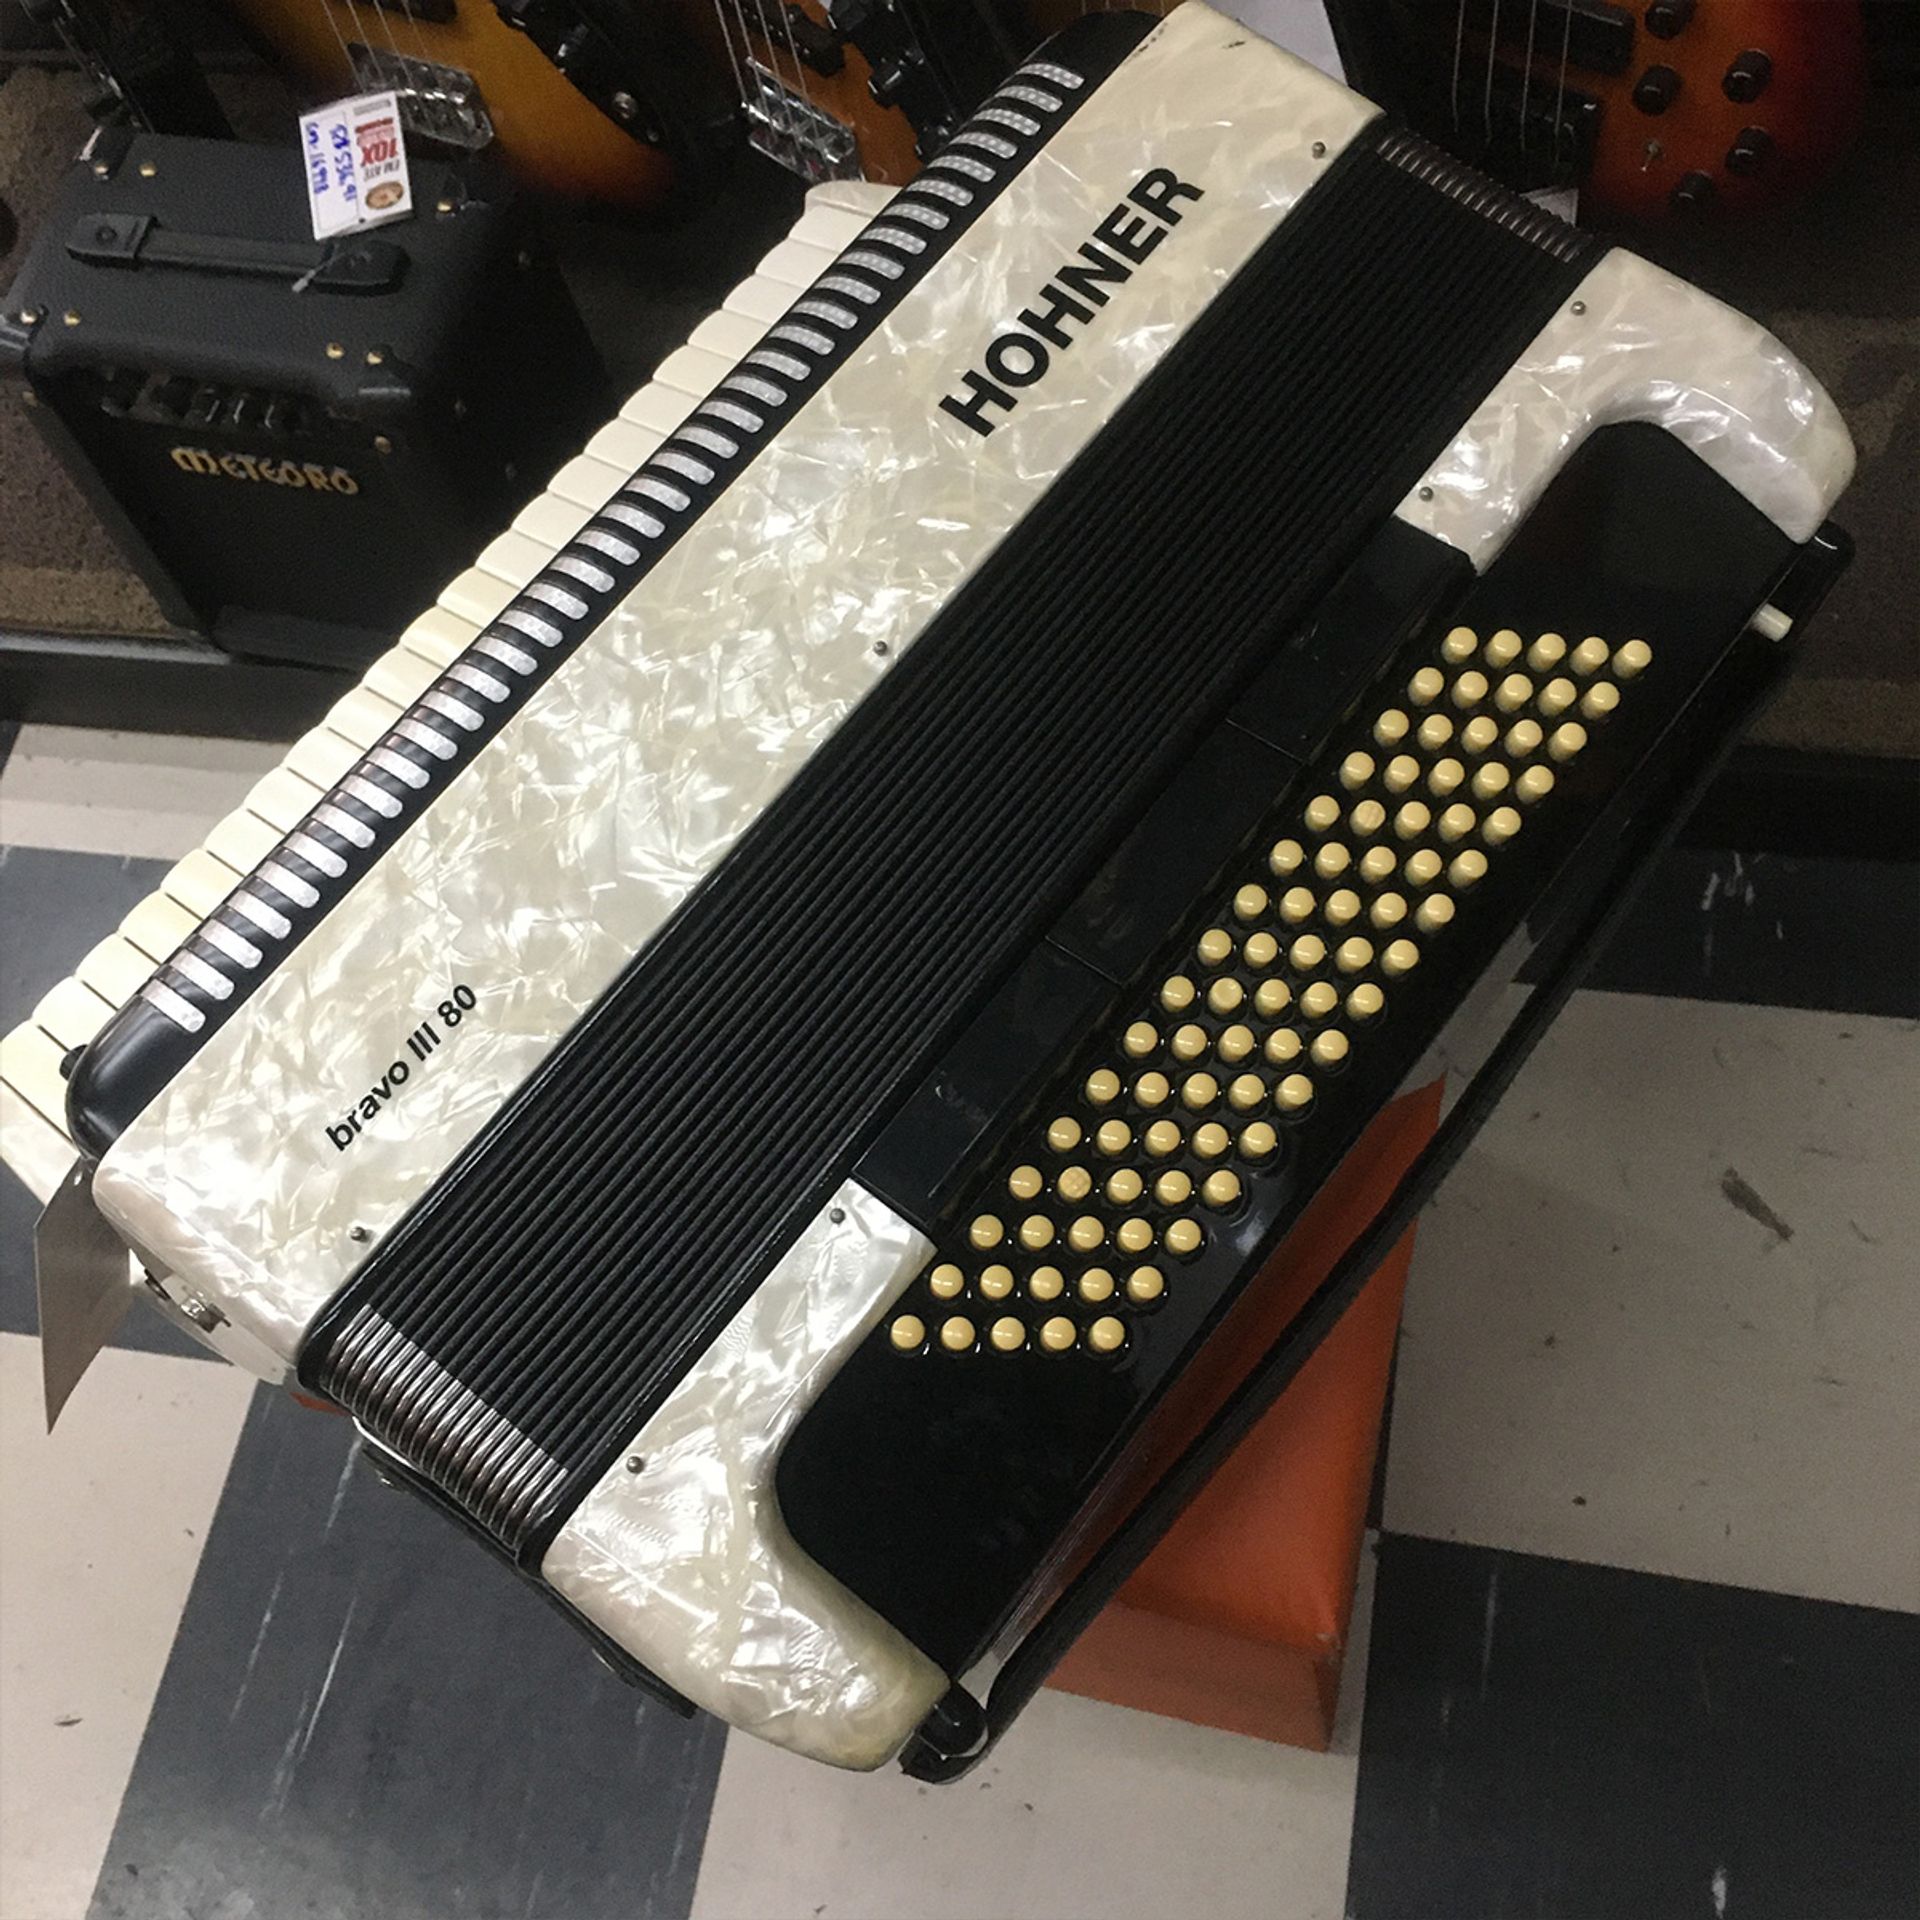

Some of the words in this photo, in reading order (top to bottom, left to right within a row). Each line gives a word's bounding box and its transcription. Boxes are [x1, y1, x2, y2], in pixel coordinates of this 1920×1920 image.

[938, 167, 1206, 438] HOHNER
[171, 446, 359, 495] METEORO
[325, 1060, 410, 1152] bravo
[406, 1021, 441, 1062] III
[437, 984, 477, 1028] 80
